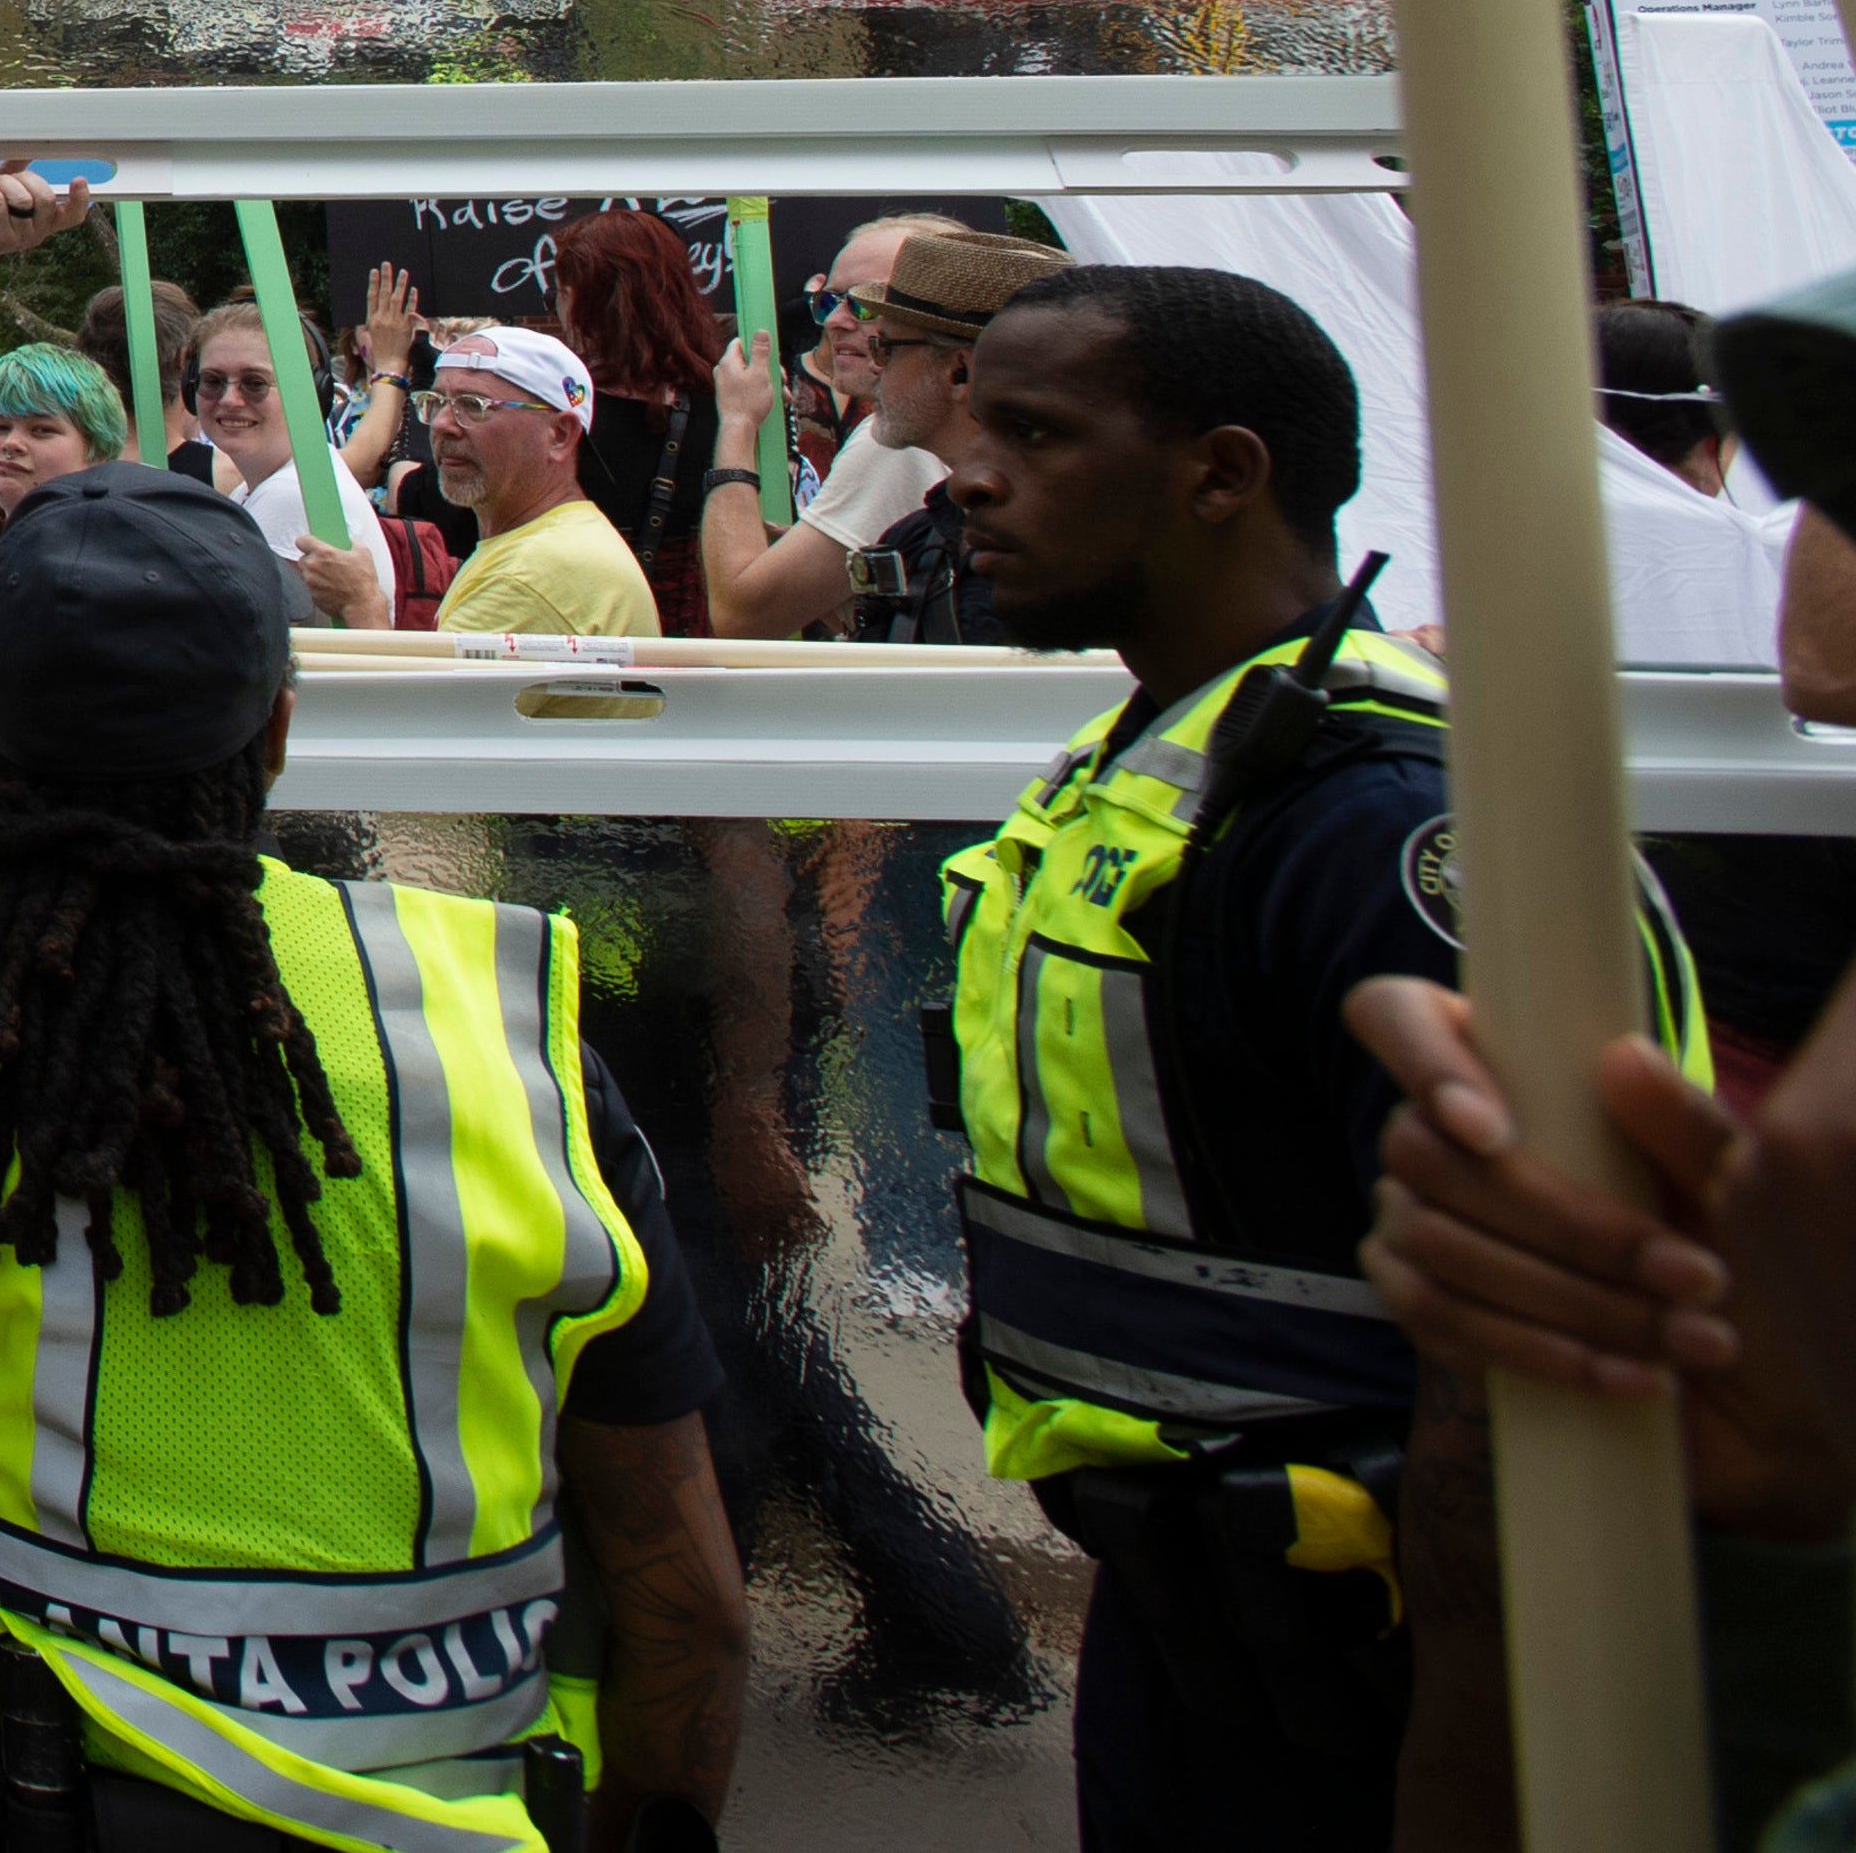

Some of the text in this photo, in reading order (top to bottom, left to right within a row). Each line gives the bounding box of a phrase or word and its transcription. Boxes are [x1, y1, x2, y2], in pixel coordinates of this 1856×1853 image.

[1702, 2, 1757, 14] Manager
[1802, 60, 1845, 71] Andrea
[323, 1597, 559, 1712] POLIC
